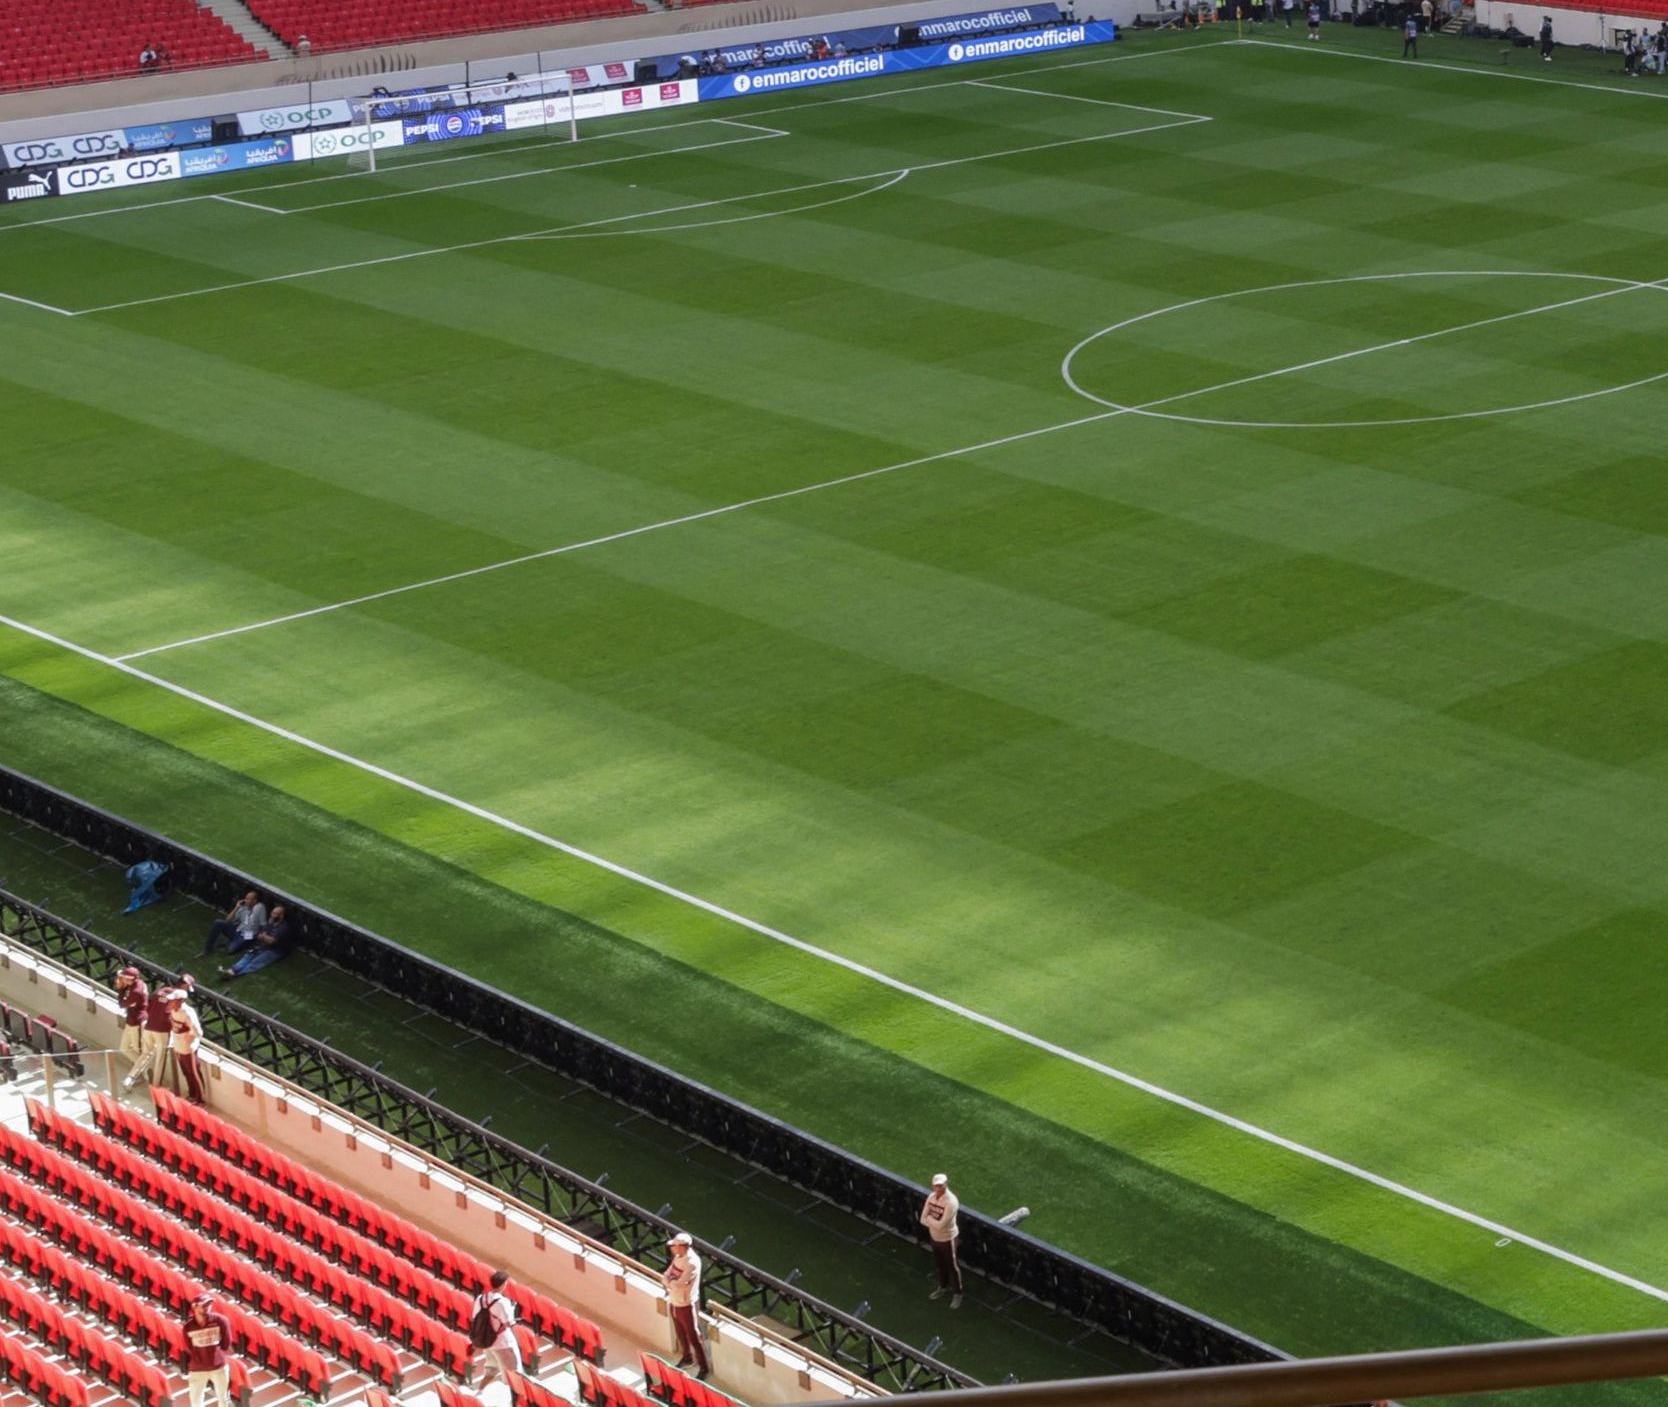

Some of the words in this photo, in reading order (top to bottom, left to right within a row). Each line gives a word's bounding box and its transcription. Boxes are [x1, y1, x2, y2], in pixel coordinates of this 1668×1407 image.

[965, 26, 1085, 57] enmarocofficiel
[752, 55, 884, 88] enmarocofficiel
[287, 108, 332, 123] OCP
[341, 130, 385, 147] OCP
[406, 124, 439, 136] PEPSI
[14, 142, 64, 162] CDG
[73, 135, 121, 153] CDG
[68, 166, 115, 188] CDG
[127, 158, 172, 179] CDG
[8, 184, 47, 200] PUMA
